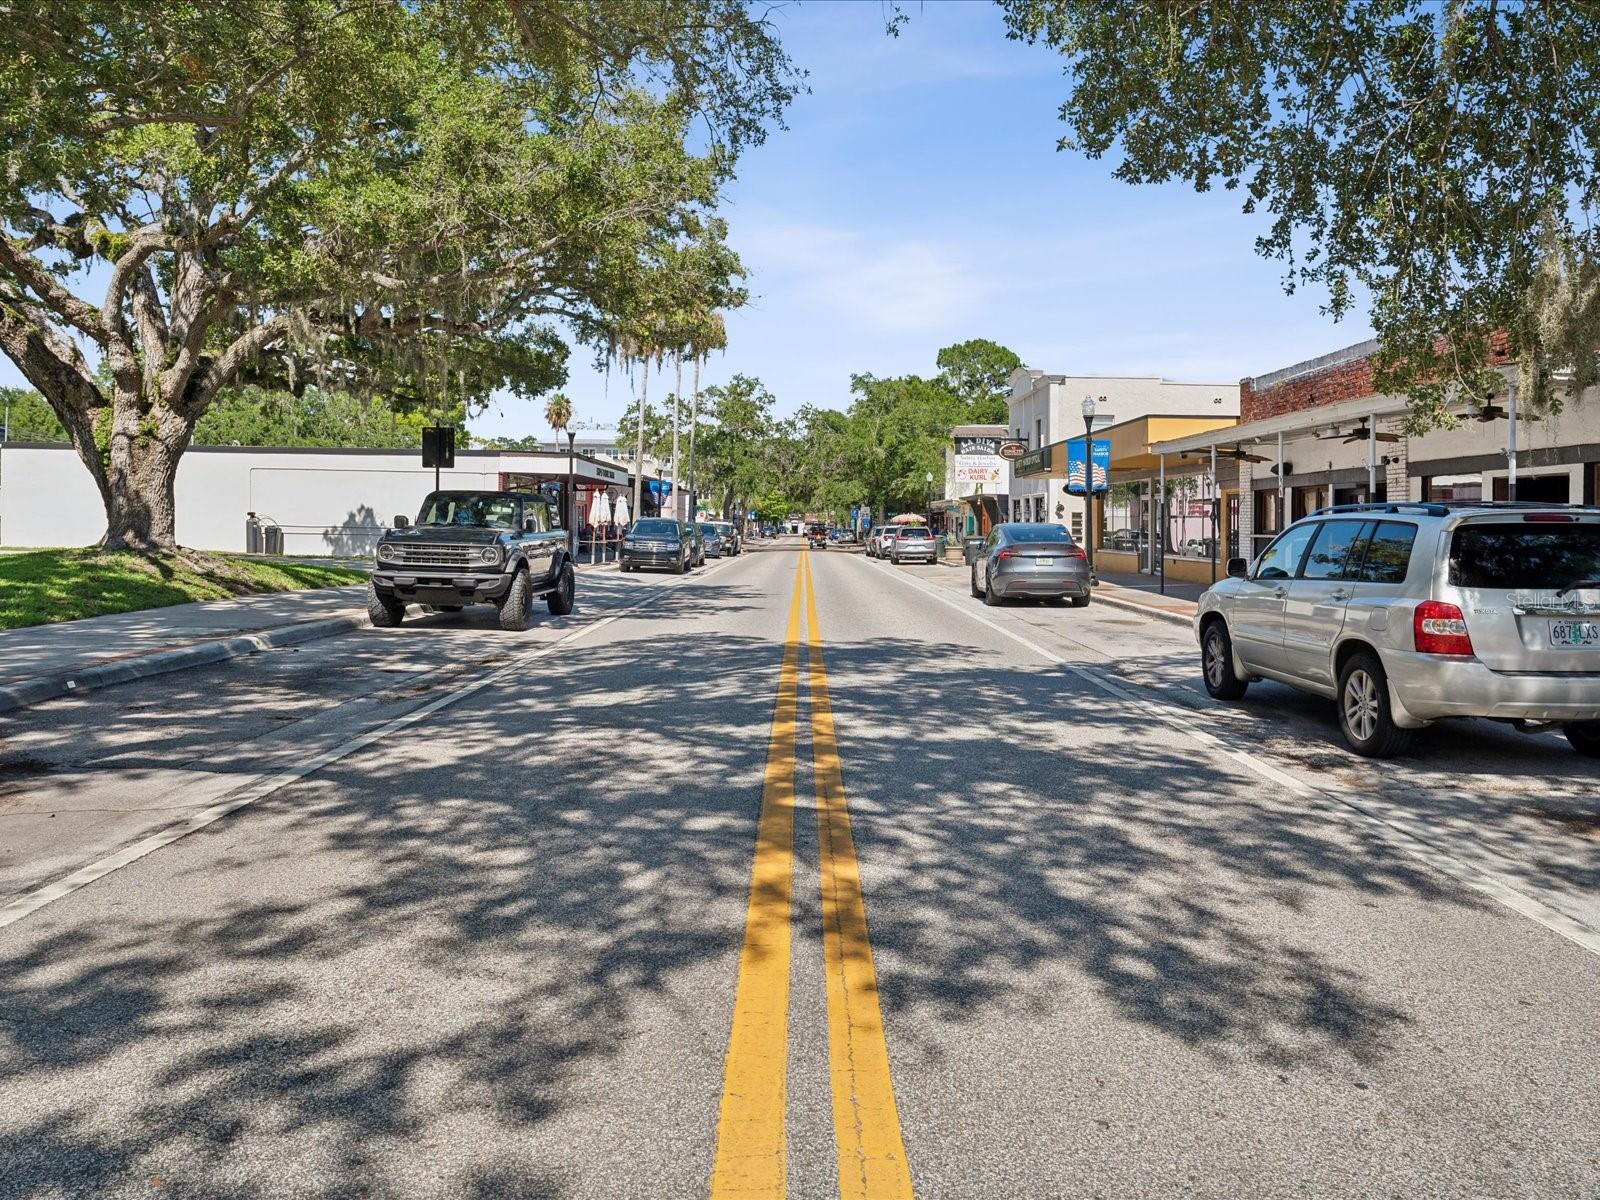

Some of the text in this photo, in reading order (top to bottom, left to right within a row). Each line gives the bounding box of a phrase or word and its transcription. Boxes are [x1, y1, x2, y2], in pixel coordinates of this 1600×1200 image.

[961, 438, 995, 448] LA DIVA
[961, 446, 975, 454] HAIR
[977, 445, 995, 454] SALON
